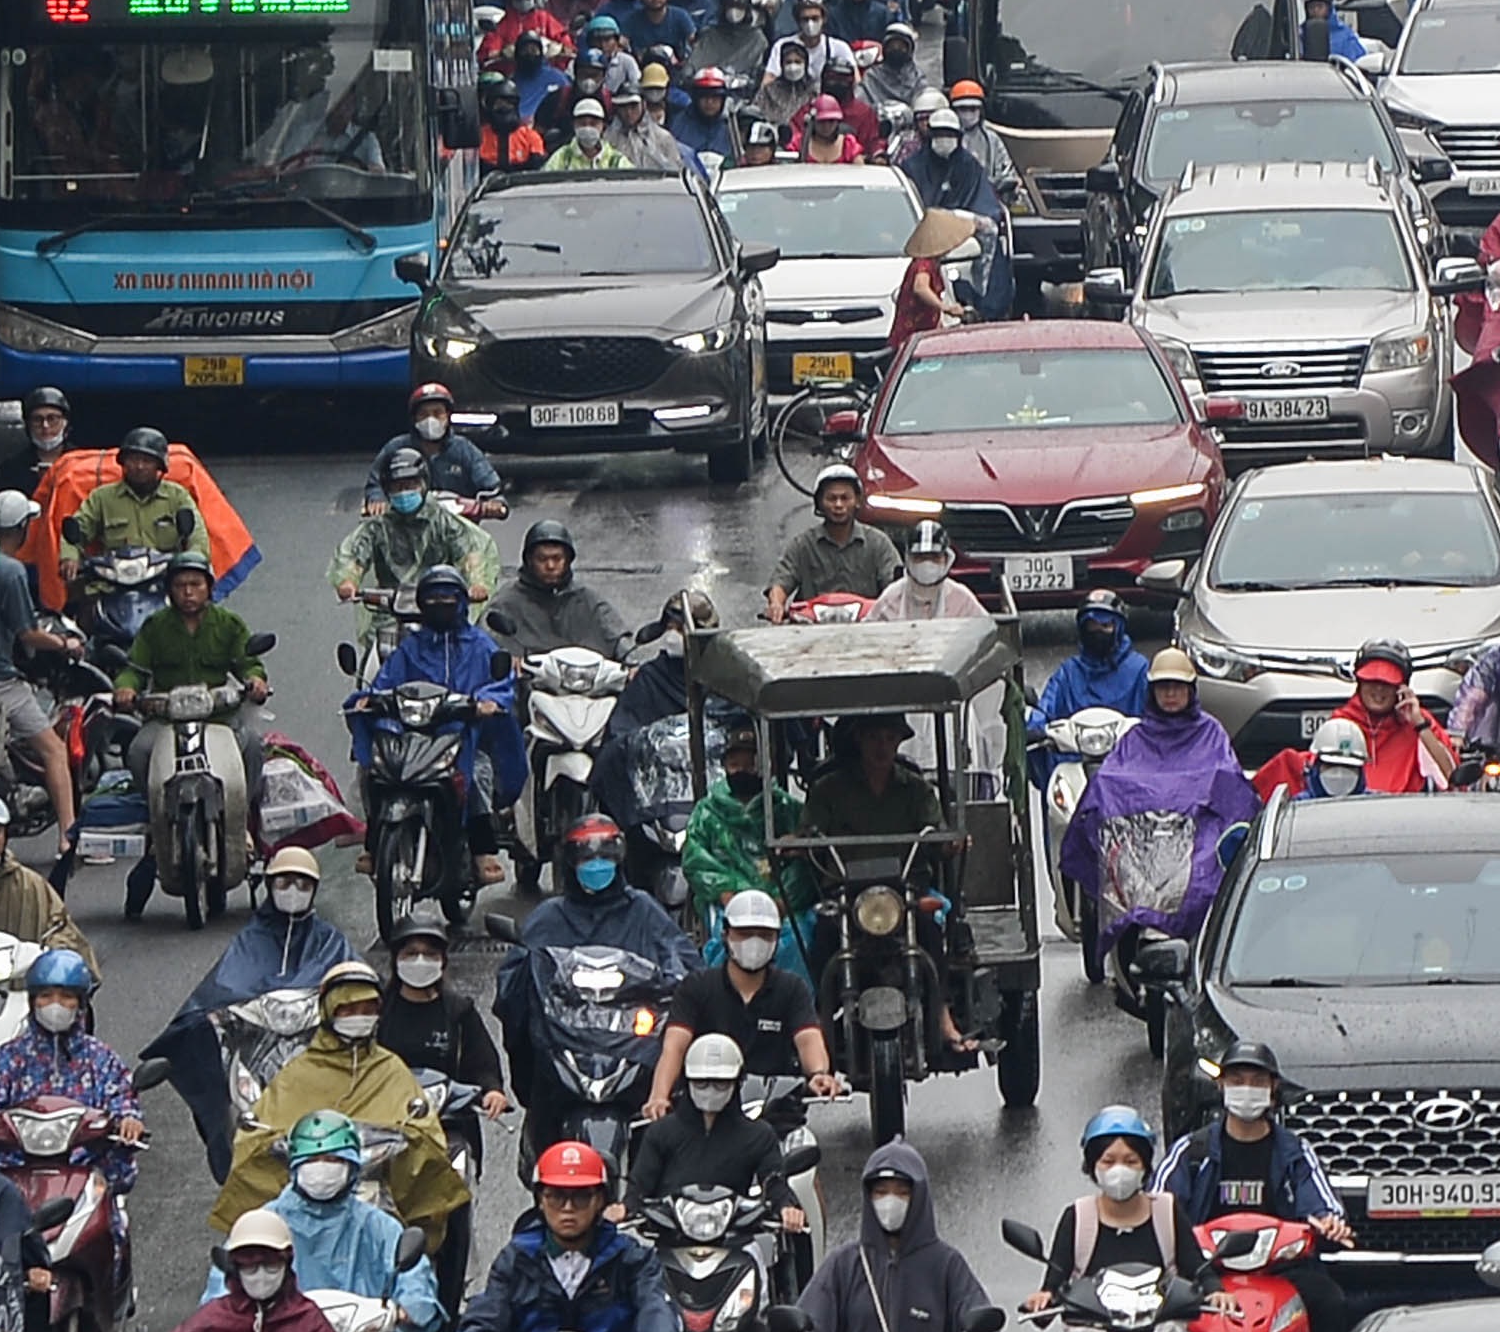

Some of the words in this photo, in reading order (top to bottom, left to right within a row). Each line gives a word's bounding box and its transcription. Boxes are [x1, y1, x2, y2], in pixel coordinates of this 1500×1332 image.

[145, 307, 285, 329] HANOIBUS
[1025, 558, 1053, 573] 30G
[1011, 574, 1066, 590] 932.22
